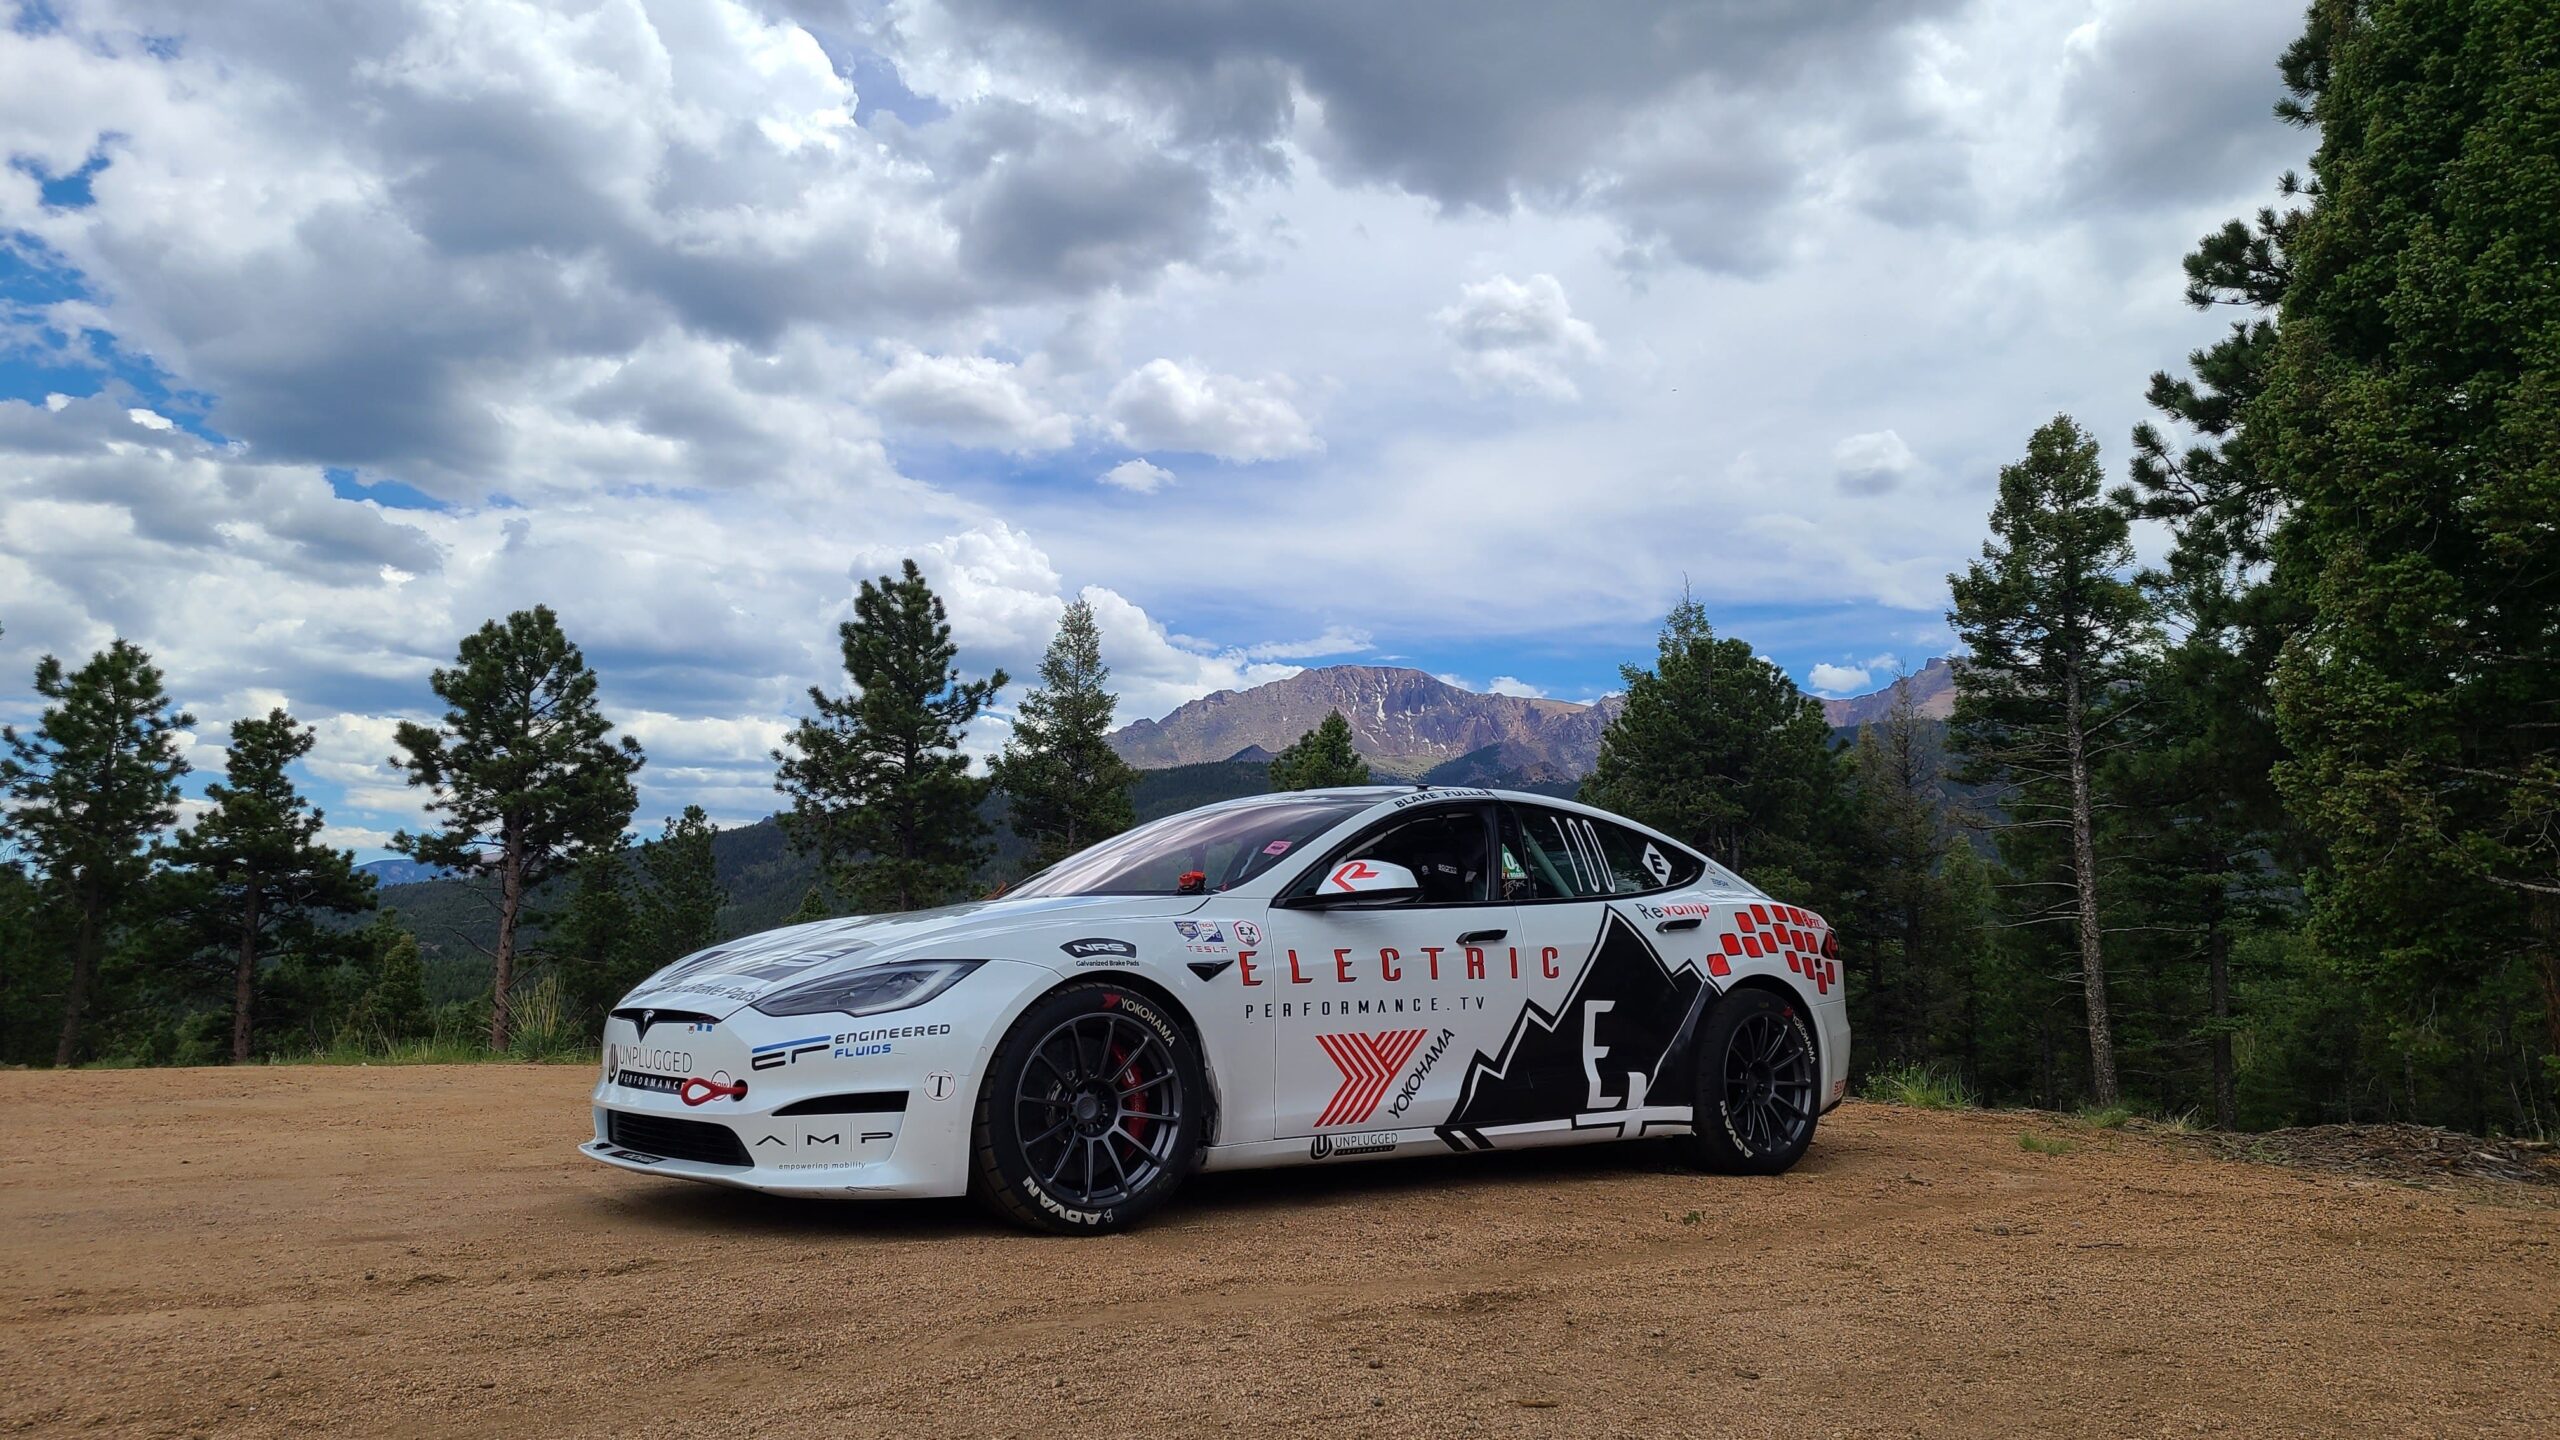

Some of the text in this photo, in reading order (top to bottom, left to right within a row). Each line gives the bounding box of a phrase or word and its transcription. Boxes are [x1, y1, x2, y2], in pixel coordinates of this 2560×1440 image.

[1394, 789, 1495, 808] BLAKE FULLER
[1550, 816, 1616, 893] 100
[1635, 903, 1710, 920] Revamp
[1238, 926, 1256, 936] EX
[1072, 943, 1127, 953] NRS
[1186, 945, 1229, 953] TESLA
[1109, 959, 1125, 967] Brake
[1126, 959, 1140, 967] Pads
[1238, 947, 1560, 987] ELECTRIC
[724, 985, 760, 1002] Pads
[1120, 997, 1176, 1047] YOKOHAMA
[834, 1024, 951, 1045] ENGINEERED
[1793, 1013, 1816, 1064] YOKOHAMA
[619, 1044, 693, 1073] UNPLUGGED
[834, 1043, 892, 1059] FLUIDS
[1388, 1028, 1455, 1119] YOKOHAMA
[930, 1075, 951, 1097] T
[1719, 1100, 1754, 1159] ADVAN
[1335, 1132, 1398, 1148] UNPLUGGED
[779, 1160, 866, 1171] empowering mobility
[1022, 1175, 1102, 1225] ADVAN
